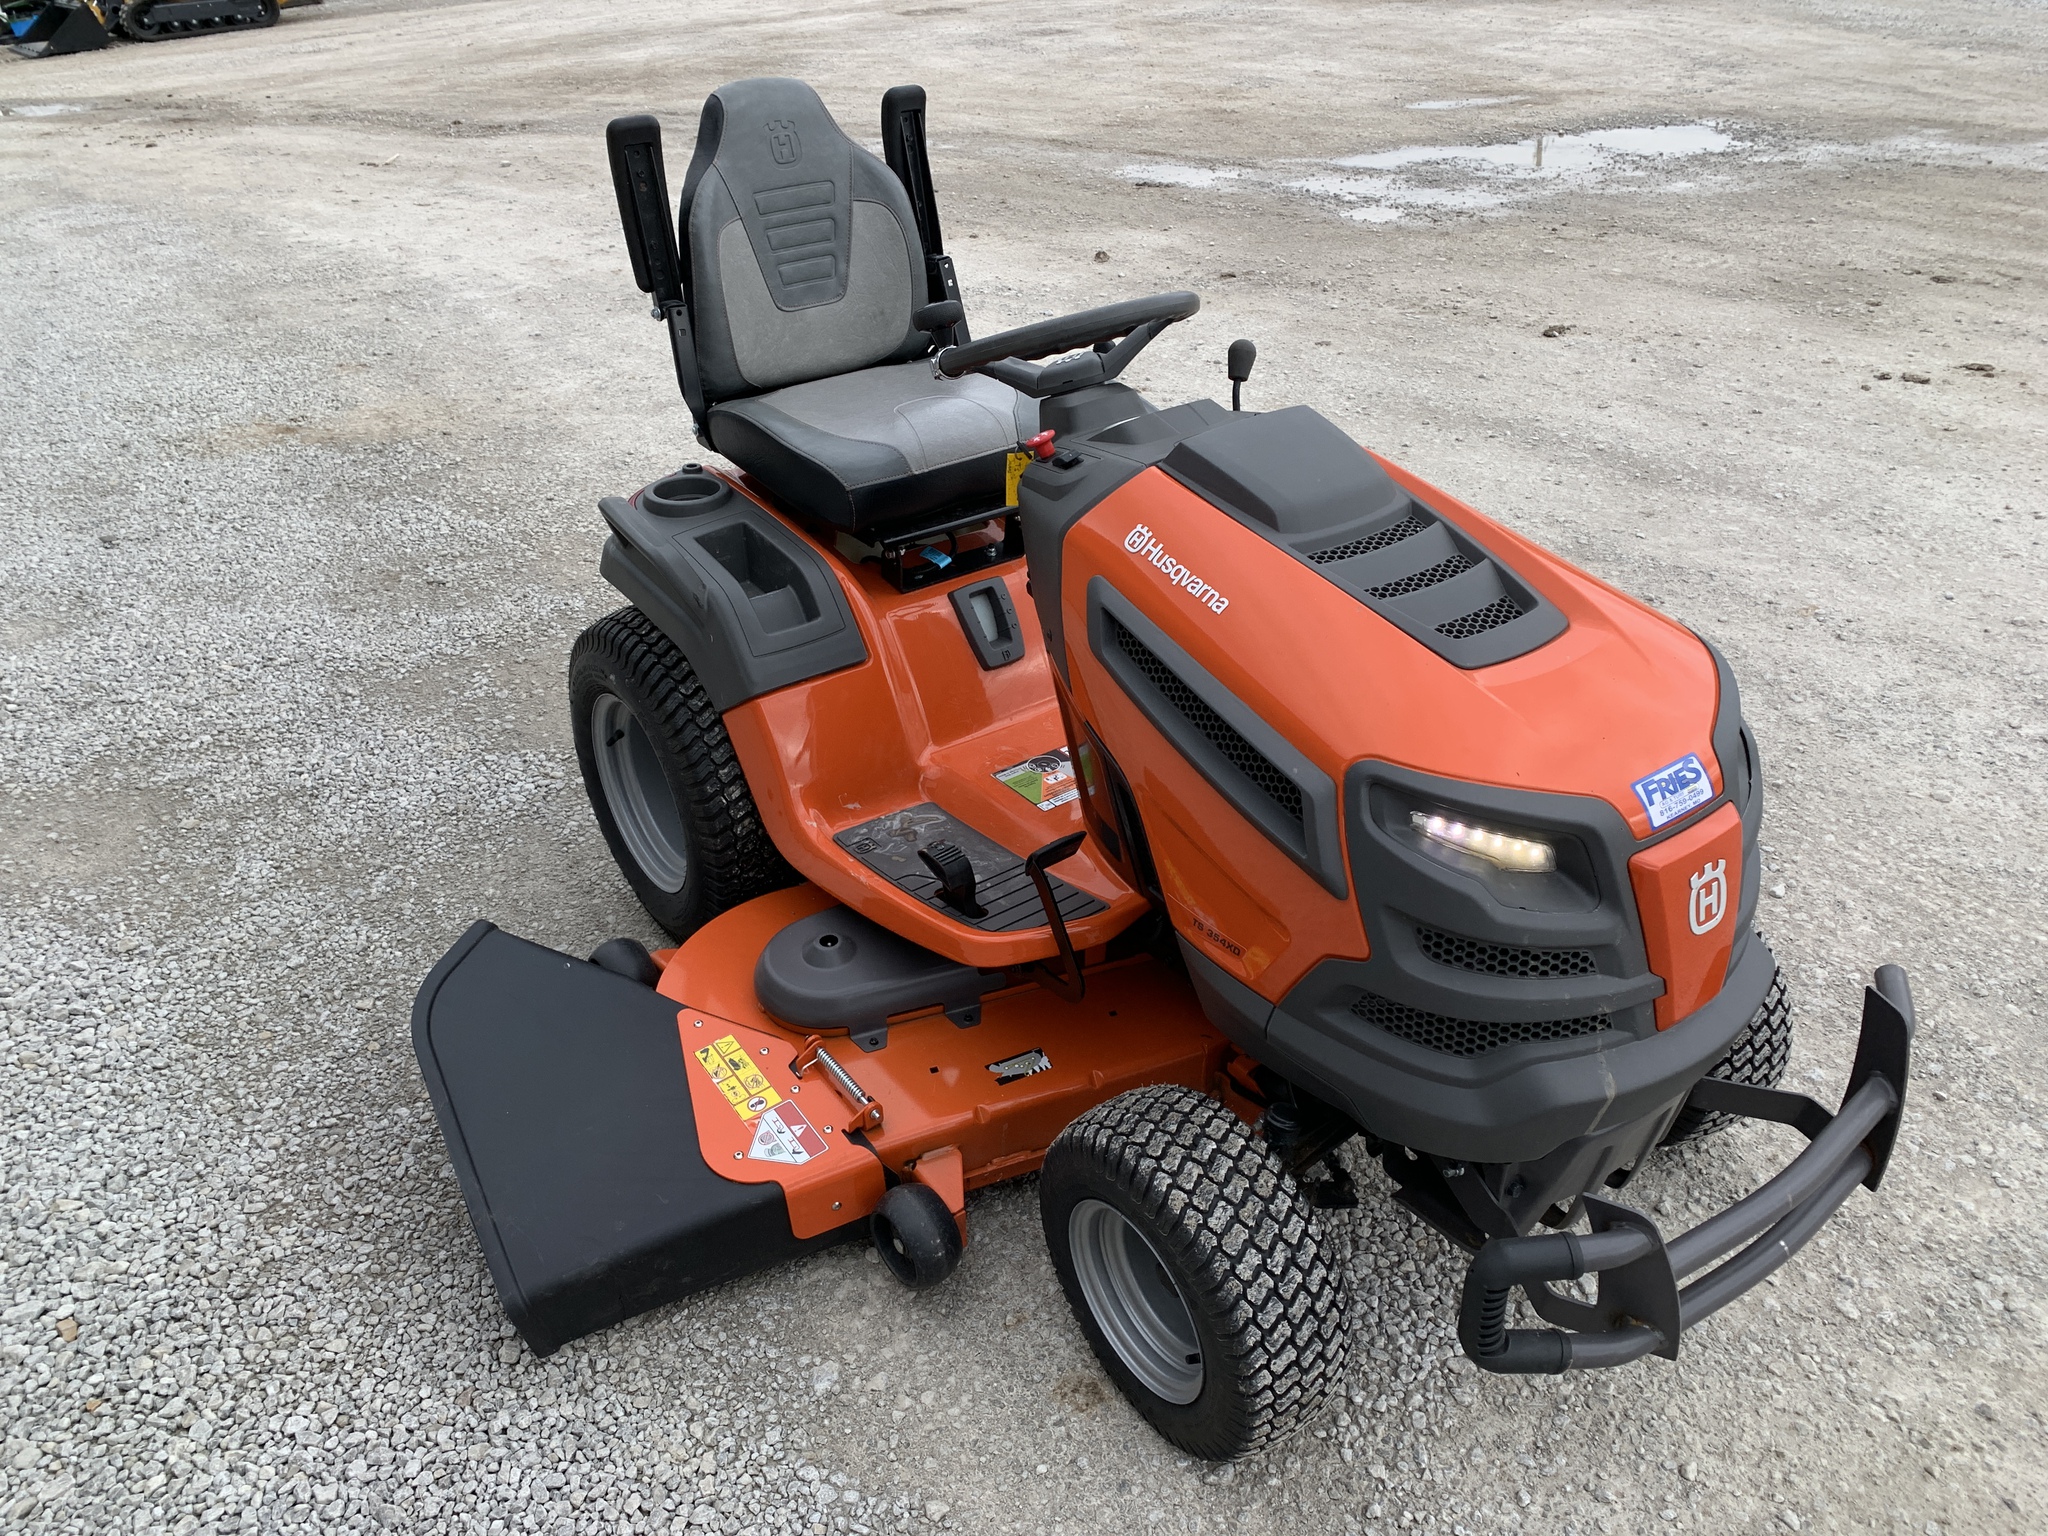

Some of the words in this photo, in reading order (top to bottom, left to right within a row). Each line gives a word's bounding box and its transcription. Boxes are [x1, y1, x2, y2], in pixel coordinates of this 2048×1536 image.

[1140, 537, 1230, 615] Husqvarna
[1641, 758, 1702, 807] FRIES
[1660, 788, 1704, 816] 816-759-0499
[1193, 918, 1204, 931] TS
[1206, 929, 1241, 956] 354XD
